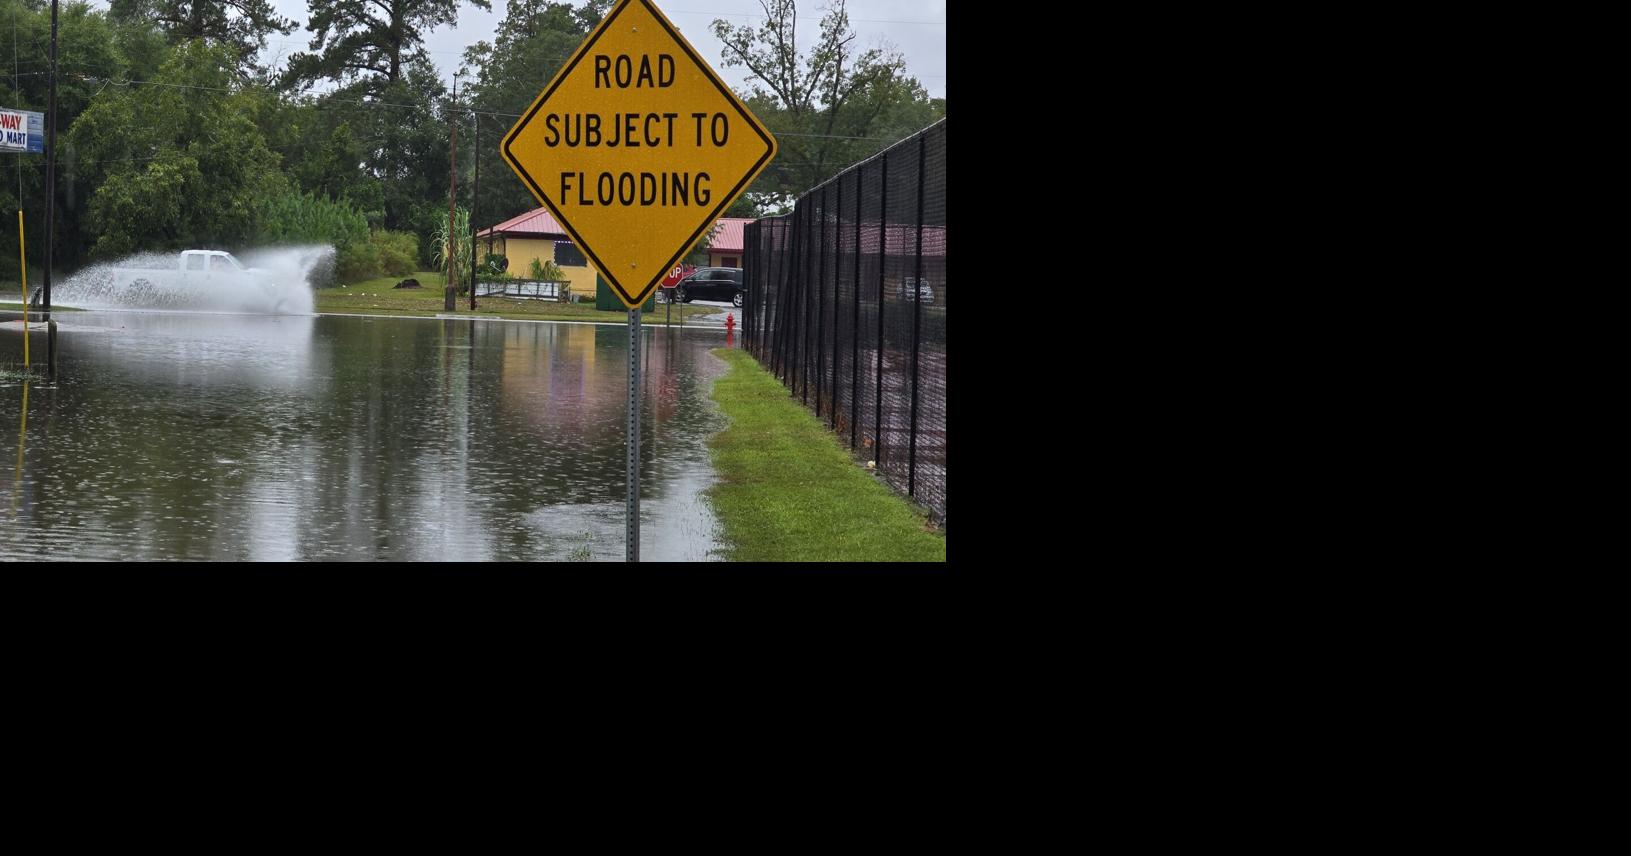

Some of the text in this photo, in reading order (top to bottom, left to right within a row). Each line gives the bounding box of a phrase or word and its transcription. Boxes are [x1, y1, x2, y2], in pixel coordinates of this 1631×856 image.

[594, 54, 675, 88] ROAD
[7, 131, 26, 145] MART
[544, 112, 729, 147] SUBJECT TO
[560, 172, 711, 206] FLOODING
[669, 267, 682, 279] OP
